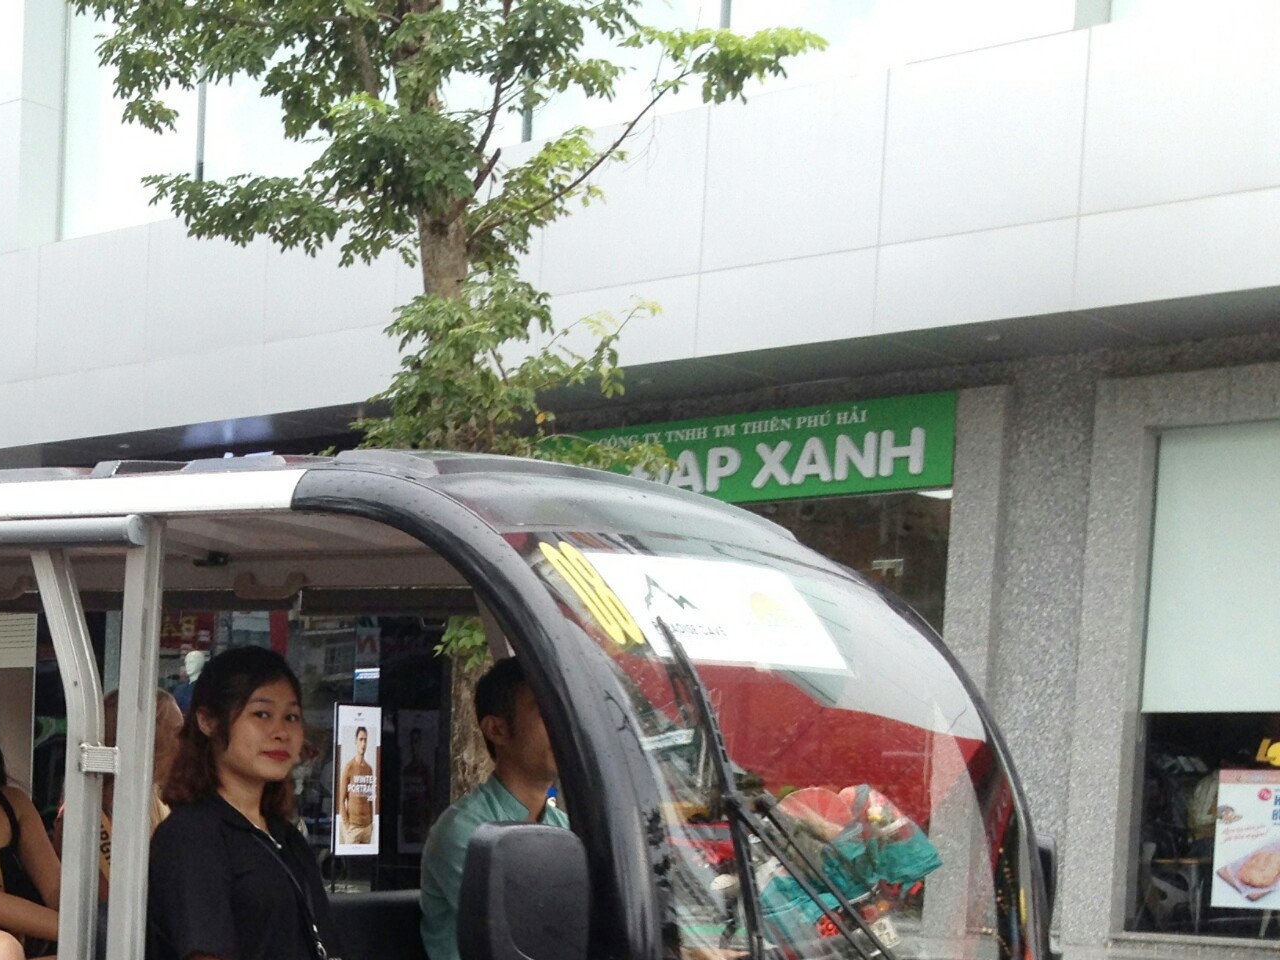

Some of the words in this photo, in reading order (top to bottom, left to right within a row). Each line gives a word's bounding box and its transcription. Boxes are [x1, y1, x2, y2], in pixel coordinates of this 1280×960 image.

[642, 431, 661, 444] TY
[665, 426, 709, 443] TNHH
[713, 423, 736, 438] TM
[740, 416, 792, 435] THIÊN
[795, 410, 831, 429] PHÚ
[836, 406, 868, 425] HẢI
[750, 426, 926, 489] XANH
[539, 540, 645, 645] 08
